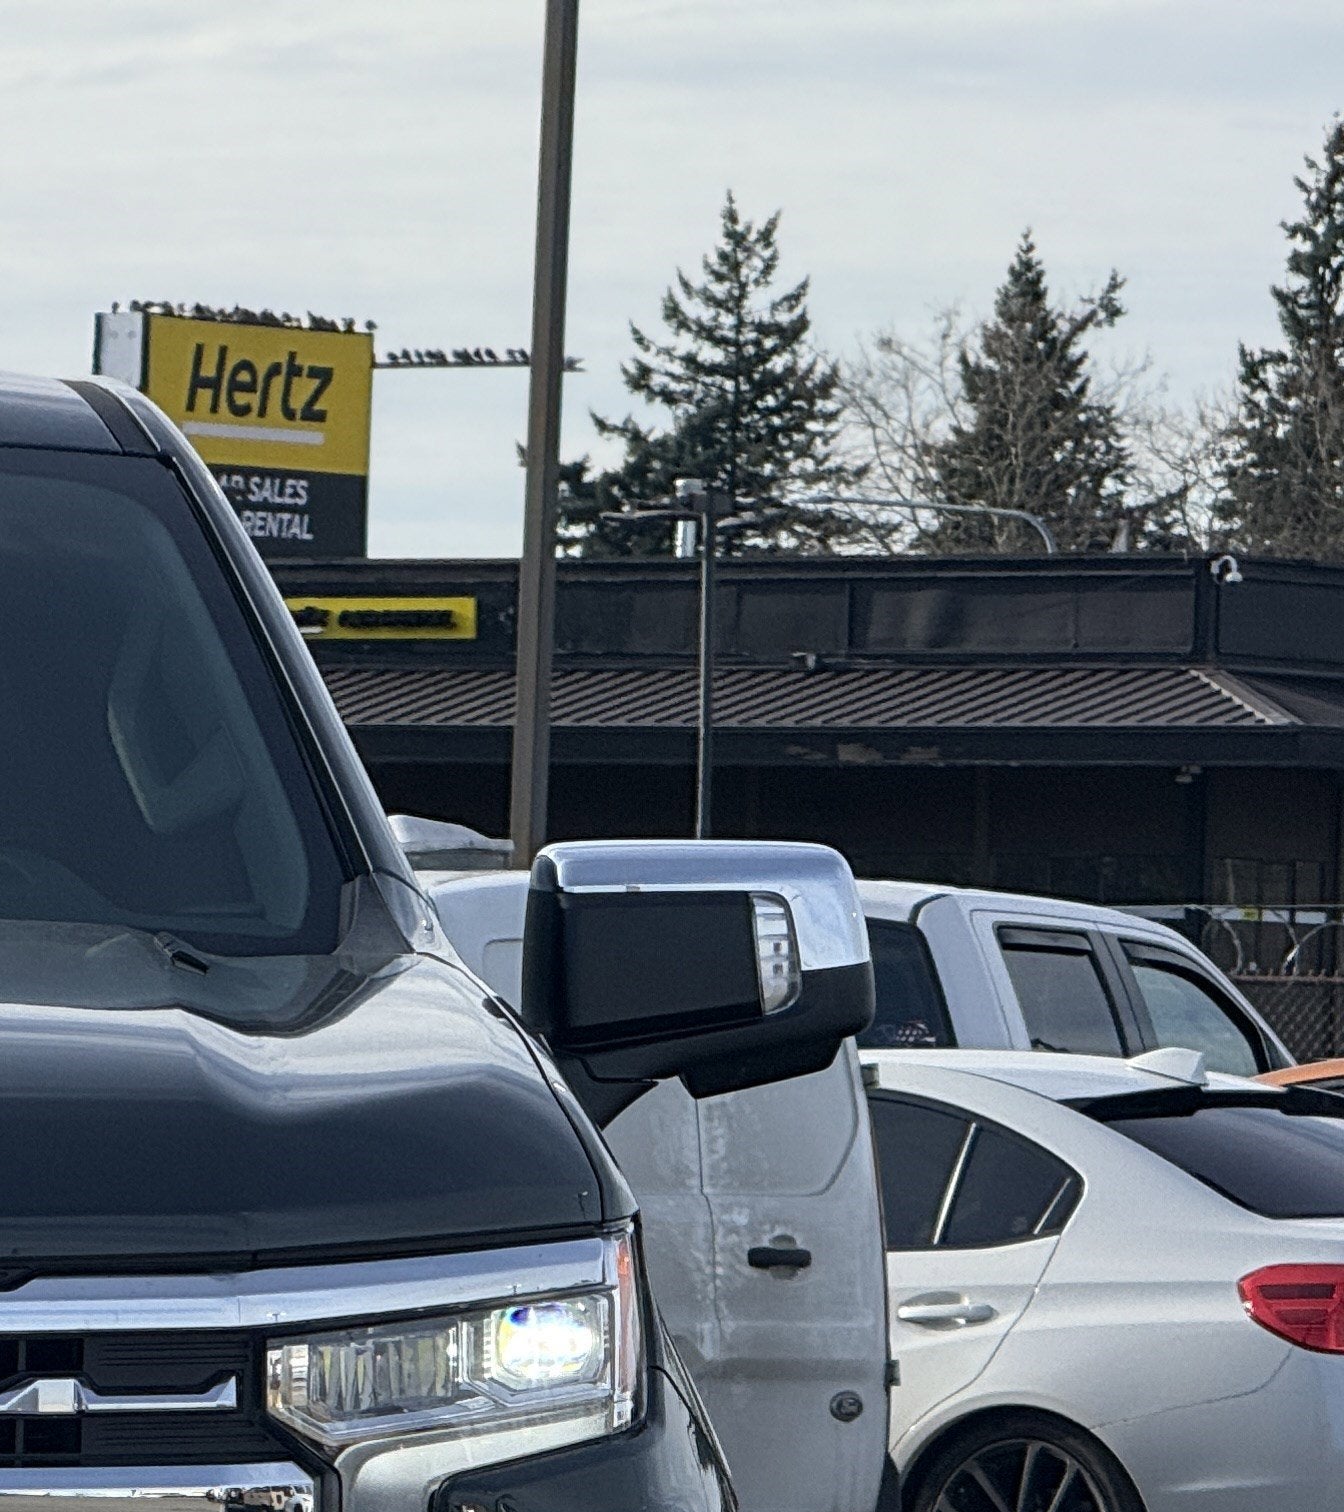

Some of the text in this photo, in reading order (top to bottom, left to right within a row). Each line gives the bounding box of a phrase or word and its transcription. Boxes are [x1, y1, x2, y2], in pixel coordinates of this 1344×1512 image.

[186, 342, 334, 423] Hertz
[248, 476, 309, 506] SALES
[241, 510, 314, 541] RENTAL
